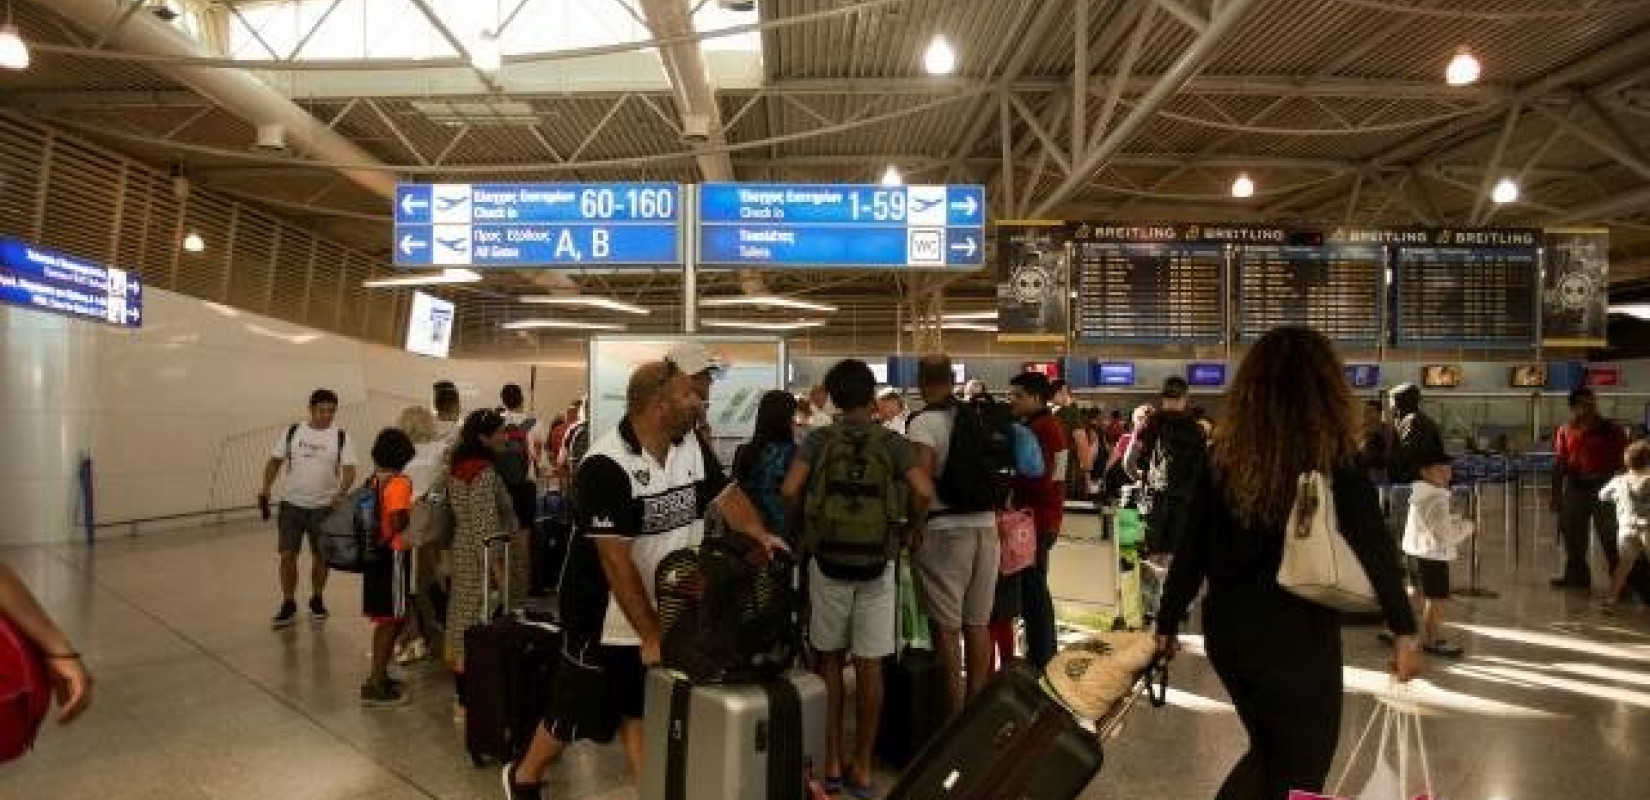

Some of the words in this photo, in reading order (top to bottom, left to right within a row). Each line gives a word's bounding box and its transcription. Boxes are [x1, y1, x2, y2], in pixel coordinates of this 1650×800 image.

[580, 188, 673, 219] 60-160
[848, 190, 906, 221] 1-59
[1095, 227, 1176, 239] BREITLING
[1203, 228, 1285, 241] BREITLING
[1350, 230, 1428, 243] BREITLING
[1455, 232, 1535, 244] BREITLING
[914, 239, 939, 255] WC
